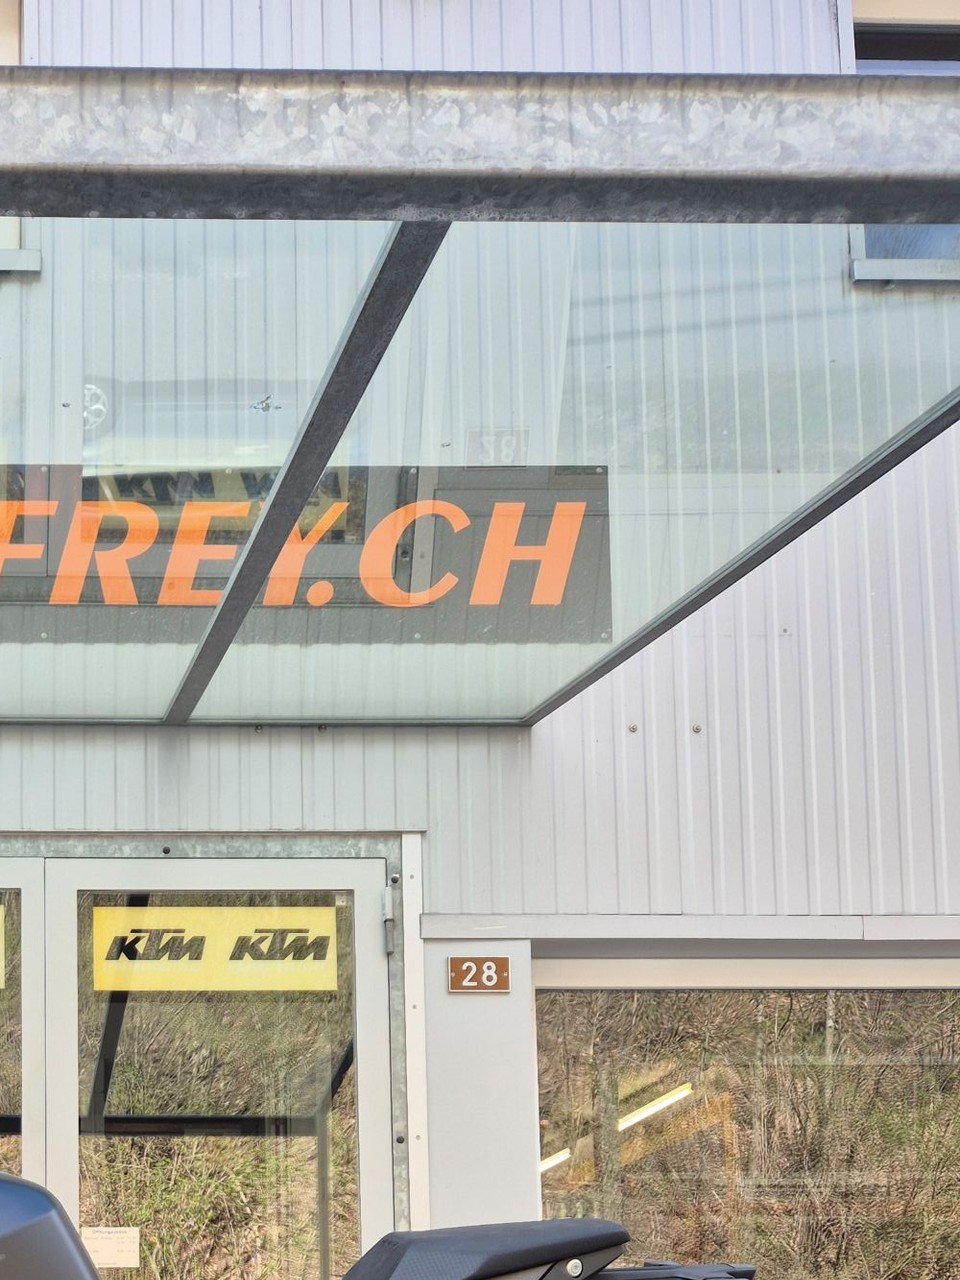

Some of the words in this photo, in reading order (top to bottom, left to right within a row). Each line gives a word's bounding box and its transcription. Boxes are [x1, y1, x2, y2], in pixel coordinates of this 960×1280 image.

[105, 929, 206, 960] KTM
[229, 929, 330, 960] KTM
[461, 961, 498, 987] 28
